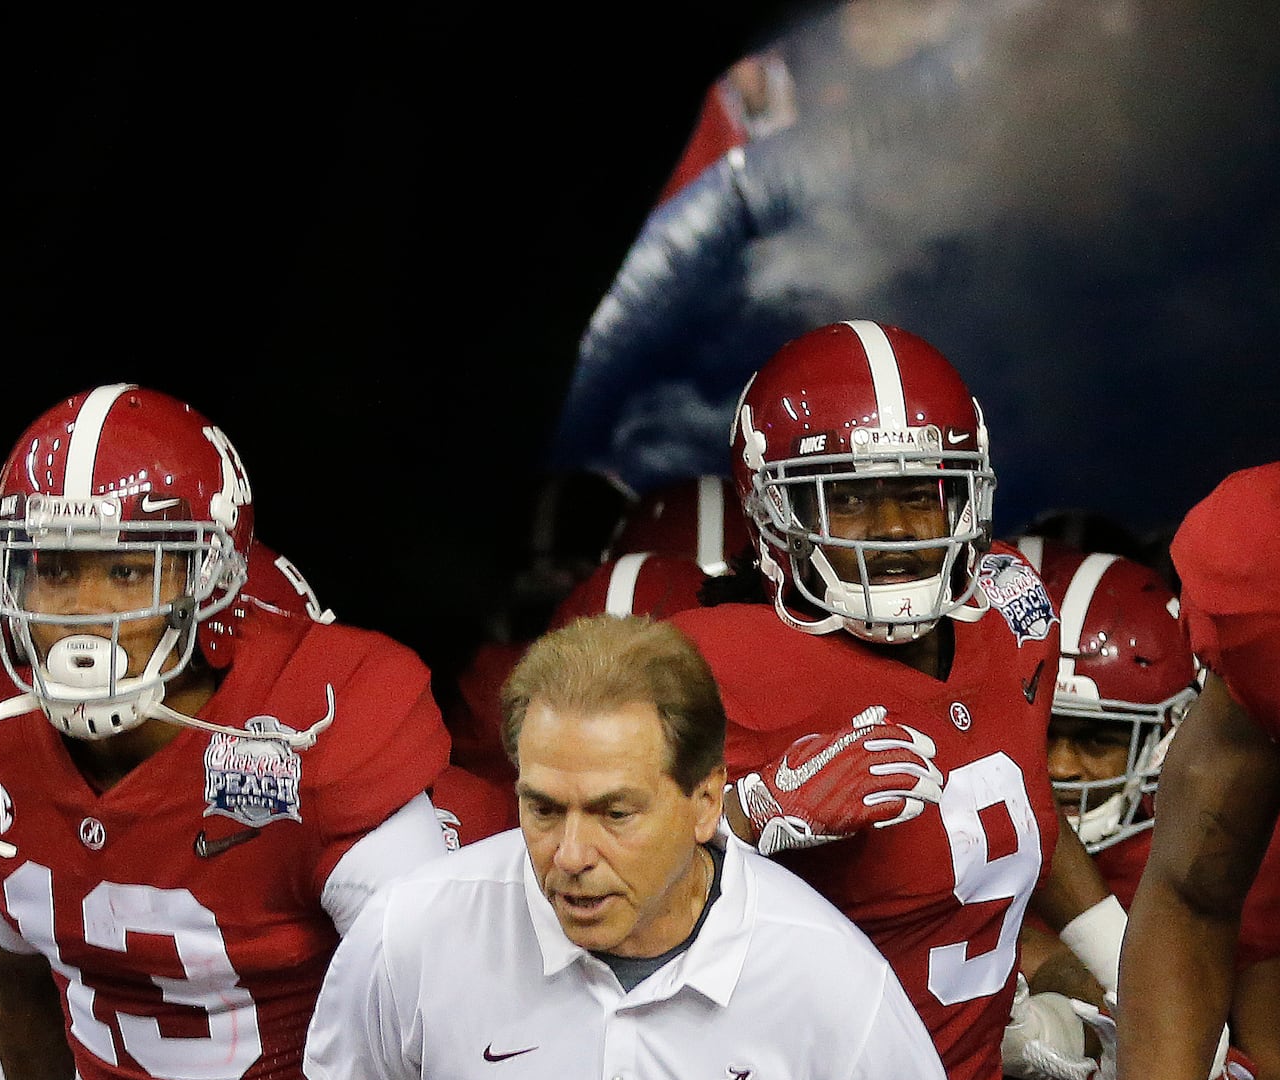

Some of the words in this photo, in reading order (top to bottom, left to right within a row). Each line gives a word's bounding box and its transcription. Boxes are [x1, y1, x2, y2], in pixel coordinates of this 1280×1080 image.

[800, 435, 827, 455] NIKE
[871, 431, 915, 444] BAMA
[53, 502, 98, 517] BAMA
[1003, 588, 1048, 626] PEACH
[1056, 680, 1078, 695] MA
[209, 772, 297, 806] PEACH
[926, 750, 1043, 1006] 9
